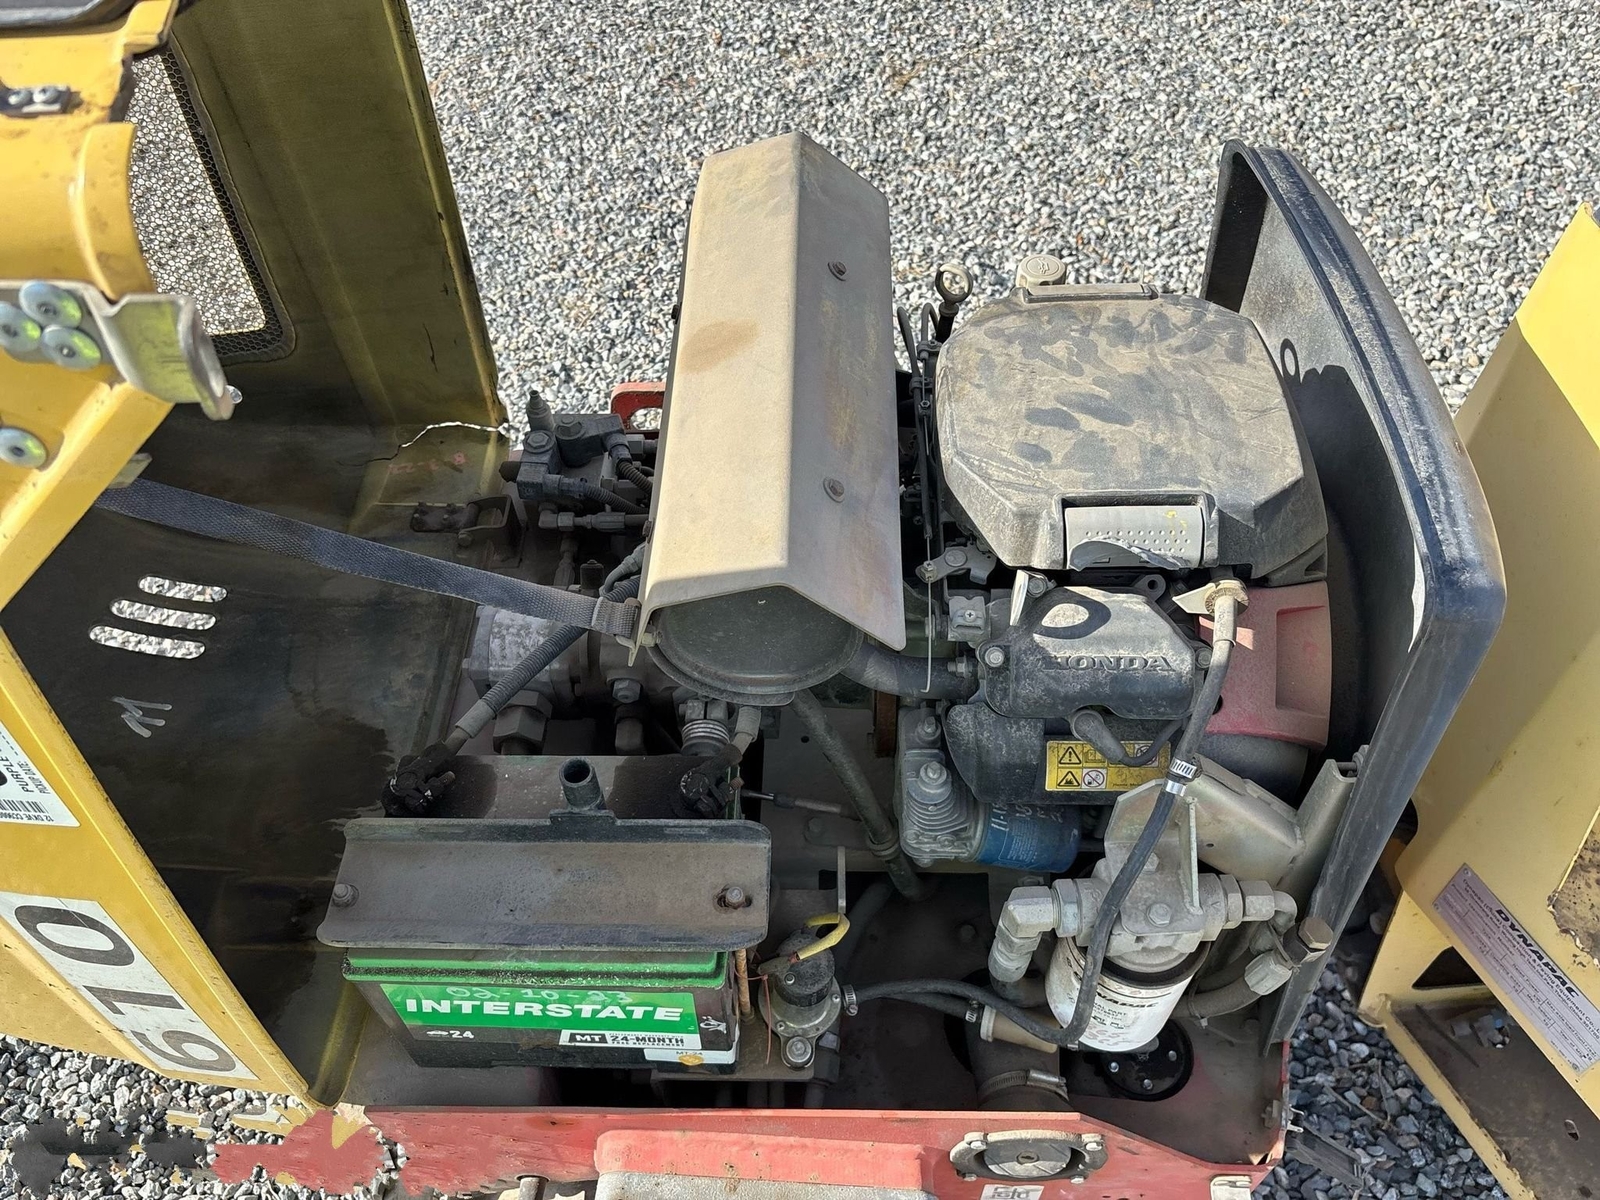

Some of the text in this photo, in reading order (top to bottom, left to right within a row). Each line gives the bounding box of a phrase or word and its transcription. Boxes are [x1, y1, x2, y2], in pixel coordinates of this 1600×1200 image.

[1042, 654, 1176, 672] HONDA
[1495, 909, 1579, 998] DYNAPAC
[14, 904, 238, 1073] 610
[405, 998, 683, 1022] INTERSTATE
[1555, 984, 1584, 1015] Equipment
[449, 1030, 475, 1039] 24
[575, 1034, 602, 1042] MT
[610, 1034, 684, 1044] 24-MONTH
